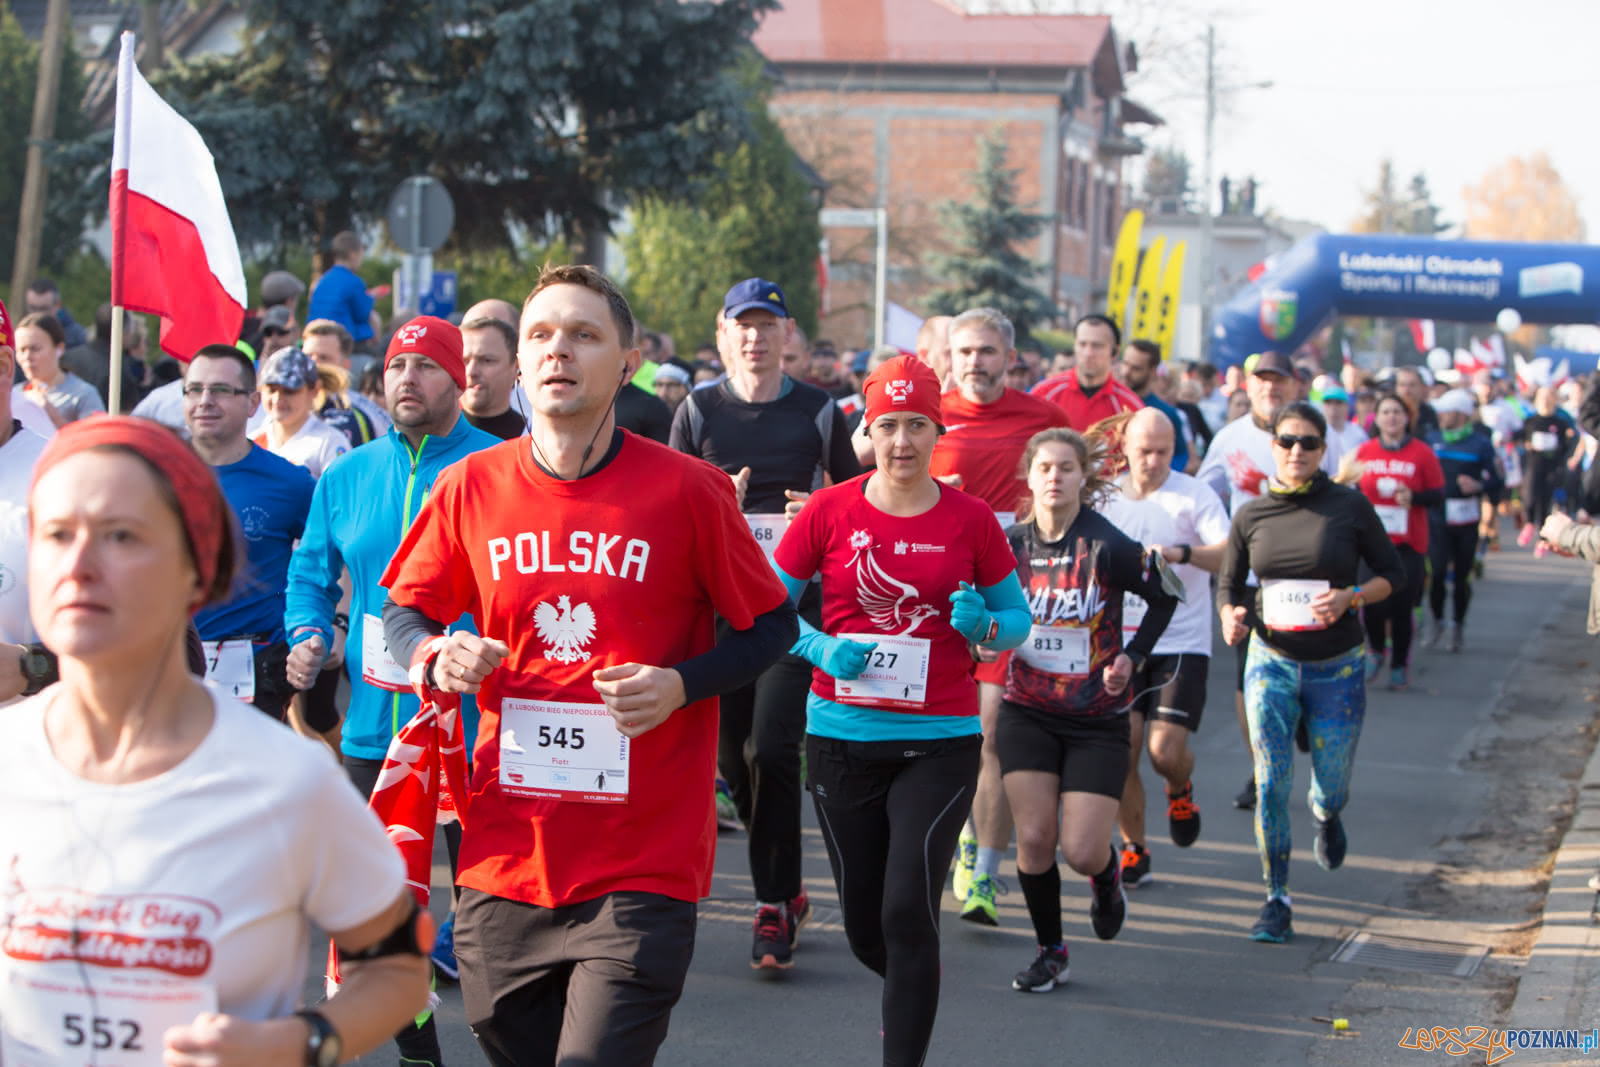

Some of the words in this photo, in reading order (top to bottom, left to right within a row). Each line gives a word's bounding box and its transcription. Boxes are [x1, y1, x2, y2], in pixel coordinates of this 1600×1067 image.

[751, 527, 773, 541] 68
[488, 530, 650, 583] POLSKA
[1034, 638, 1063, 651] 813
[546, 706, 562, 714] BIEG
[538, 725, 585, 750] 545
[551, 757, 569, 766] Piotr
[63, 1013, 142, 1051] 552
